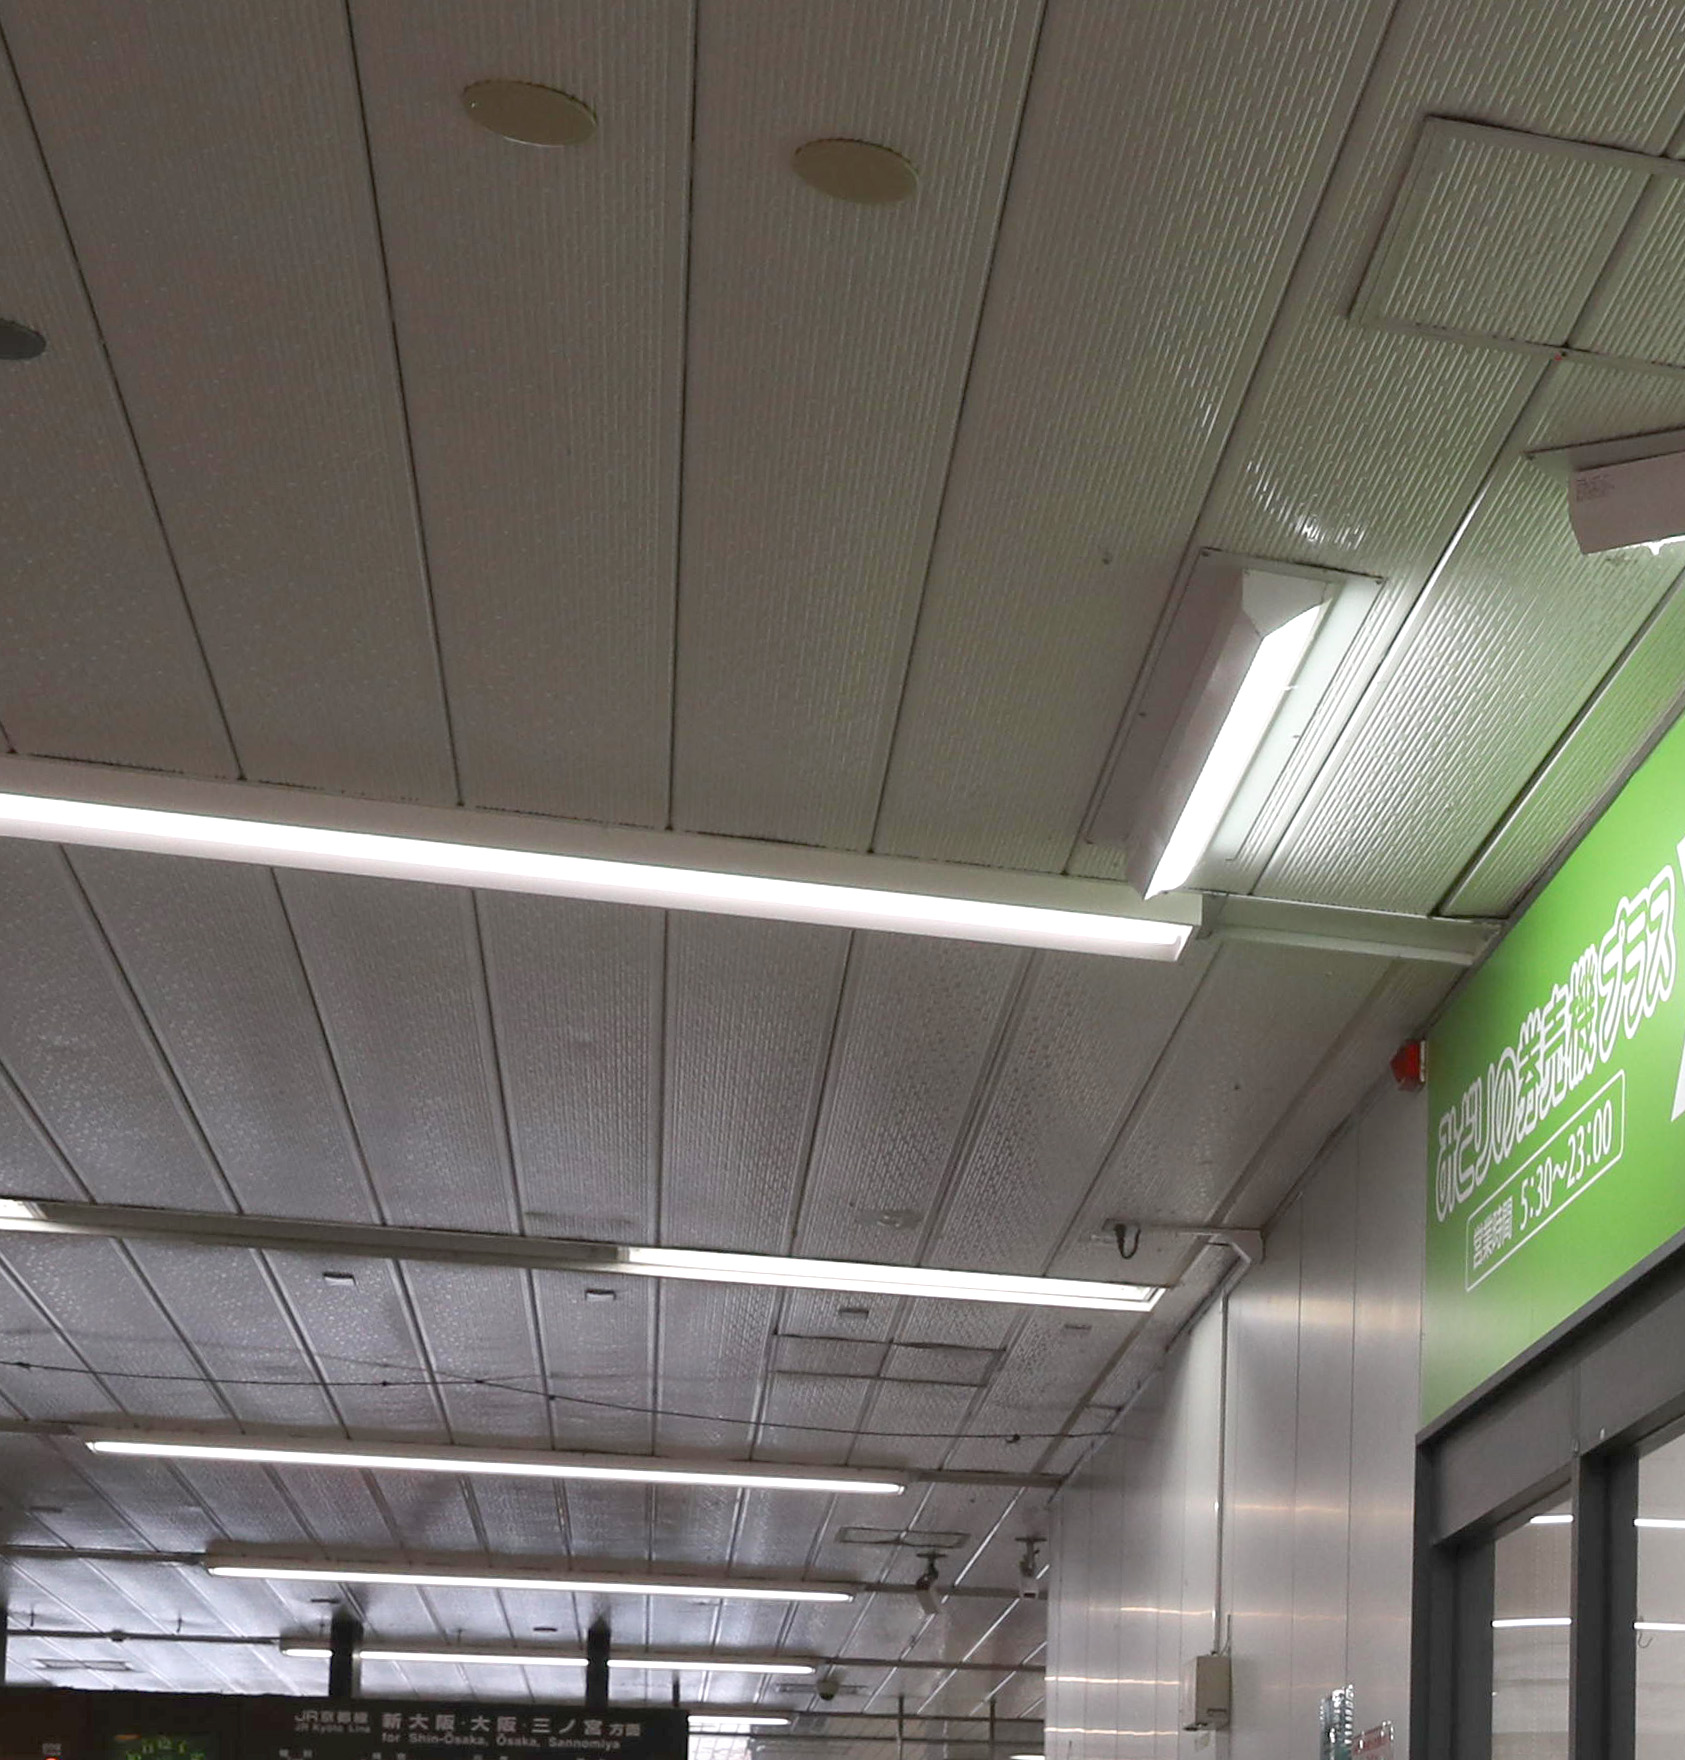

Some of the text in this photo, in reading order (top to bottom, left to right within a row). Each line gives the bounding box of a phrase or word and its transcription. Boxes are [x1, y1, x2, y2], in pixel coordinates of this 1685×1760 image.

[1435, 864, 1676, 1222] みどりの券売機プラス
